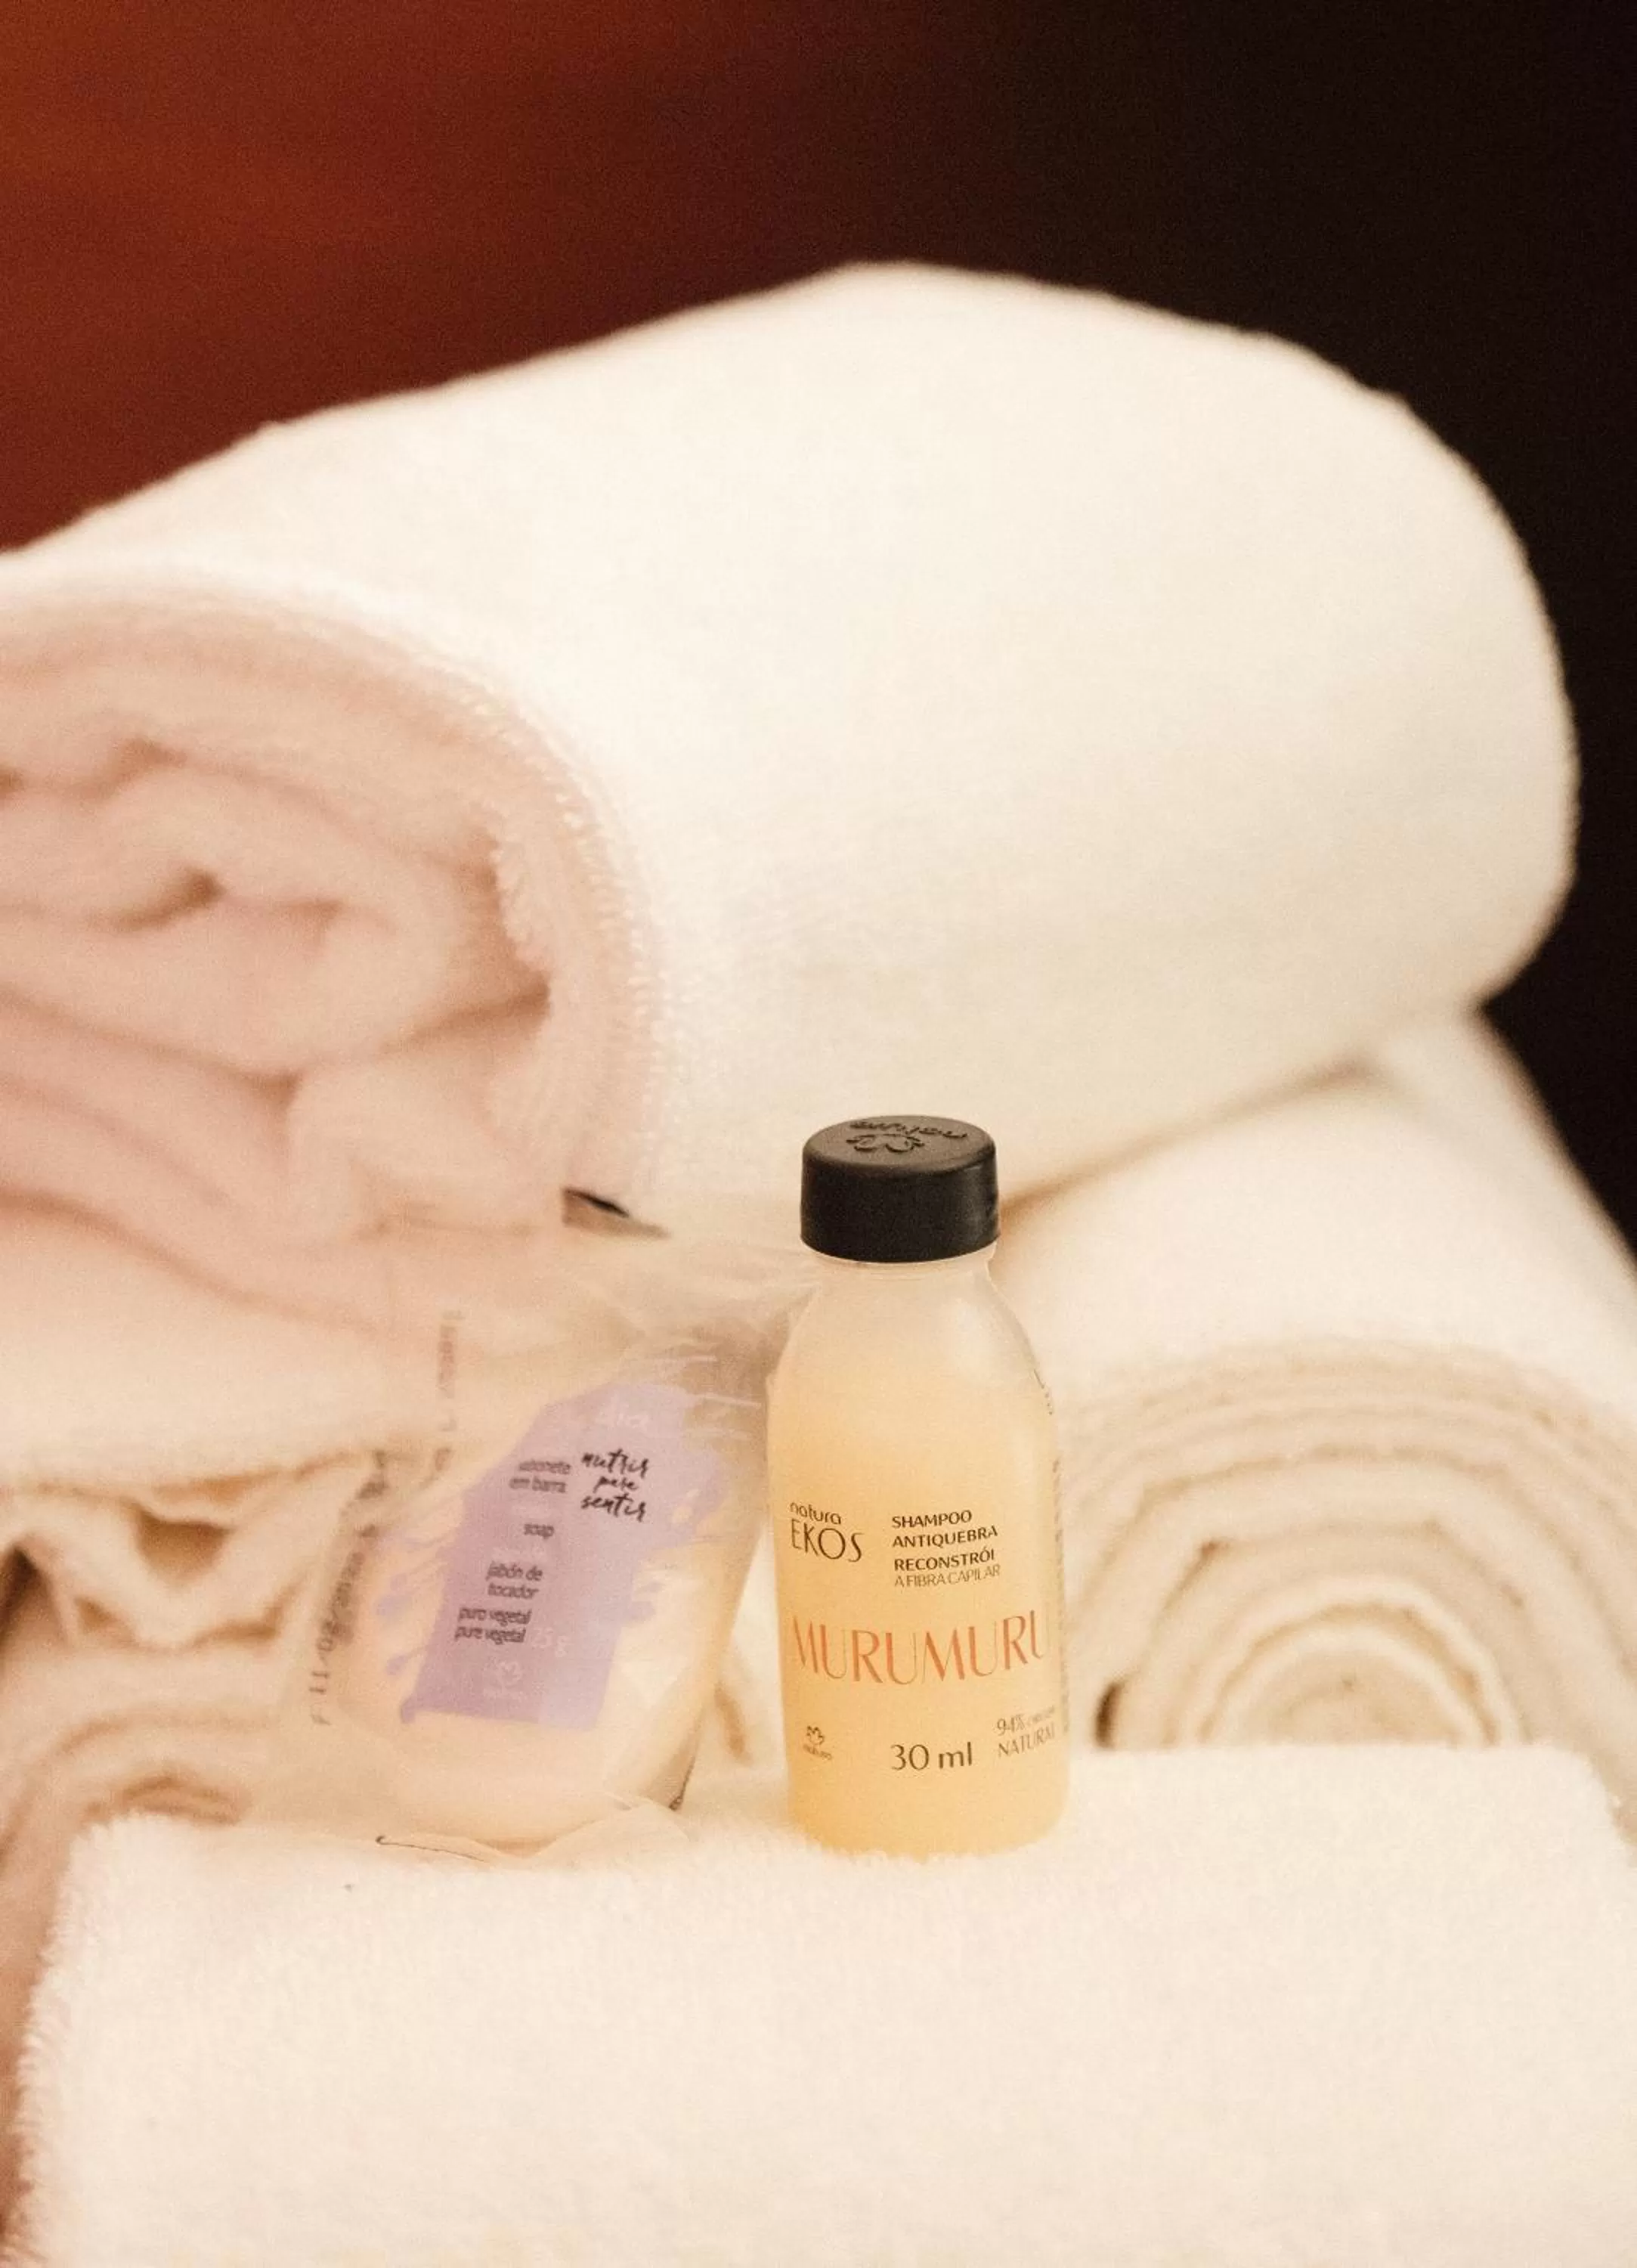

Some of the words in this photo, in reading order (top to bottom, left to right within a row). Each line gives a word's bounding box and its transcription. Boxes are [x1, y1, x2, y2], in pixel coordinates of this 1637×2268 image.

[580, 1448, 649, 1479] nutrir
[580, 1492, 647, 1523] sentir
[790, 1501, 842, 1526] natura
[892, 1509, 973, 1529] SHAMPOO
[524, 1523, 555, 1540] soap
[791, 1519, 865, 1563] EKOS
[892, 1525, 999, 1549] ANTIQUEBRA
[894, 1548, 995, 1572] RECONSTRÓI
[525, 1563, 543, 1582] de
[894, 1575, 905, 1588] A
[906, 1573, 946, 1588] FIBRA
[948, 1563, 1001, 1586] CAPILAR
[487, 1583, 539, 1600] tocador
[489, 1609, 532, 1627] vegetal
[485, 1627, 527, 1646] vegetal
[793, 1609, 1051, 1686] MURUMURU
[890, 1743, 930, 1771] 30
[939, 1741, 973, 1770] ml
